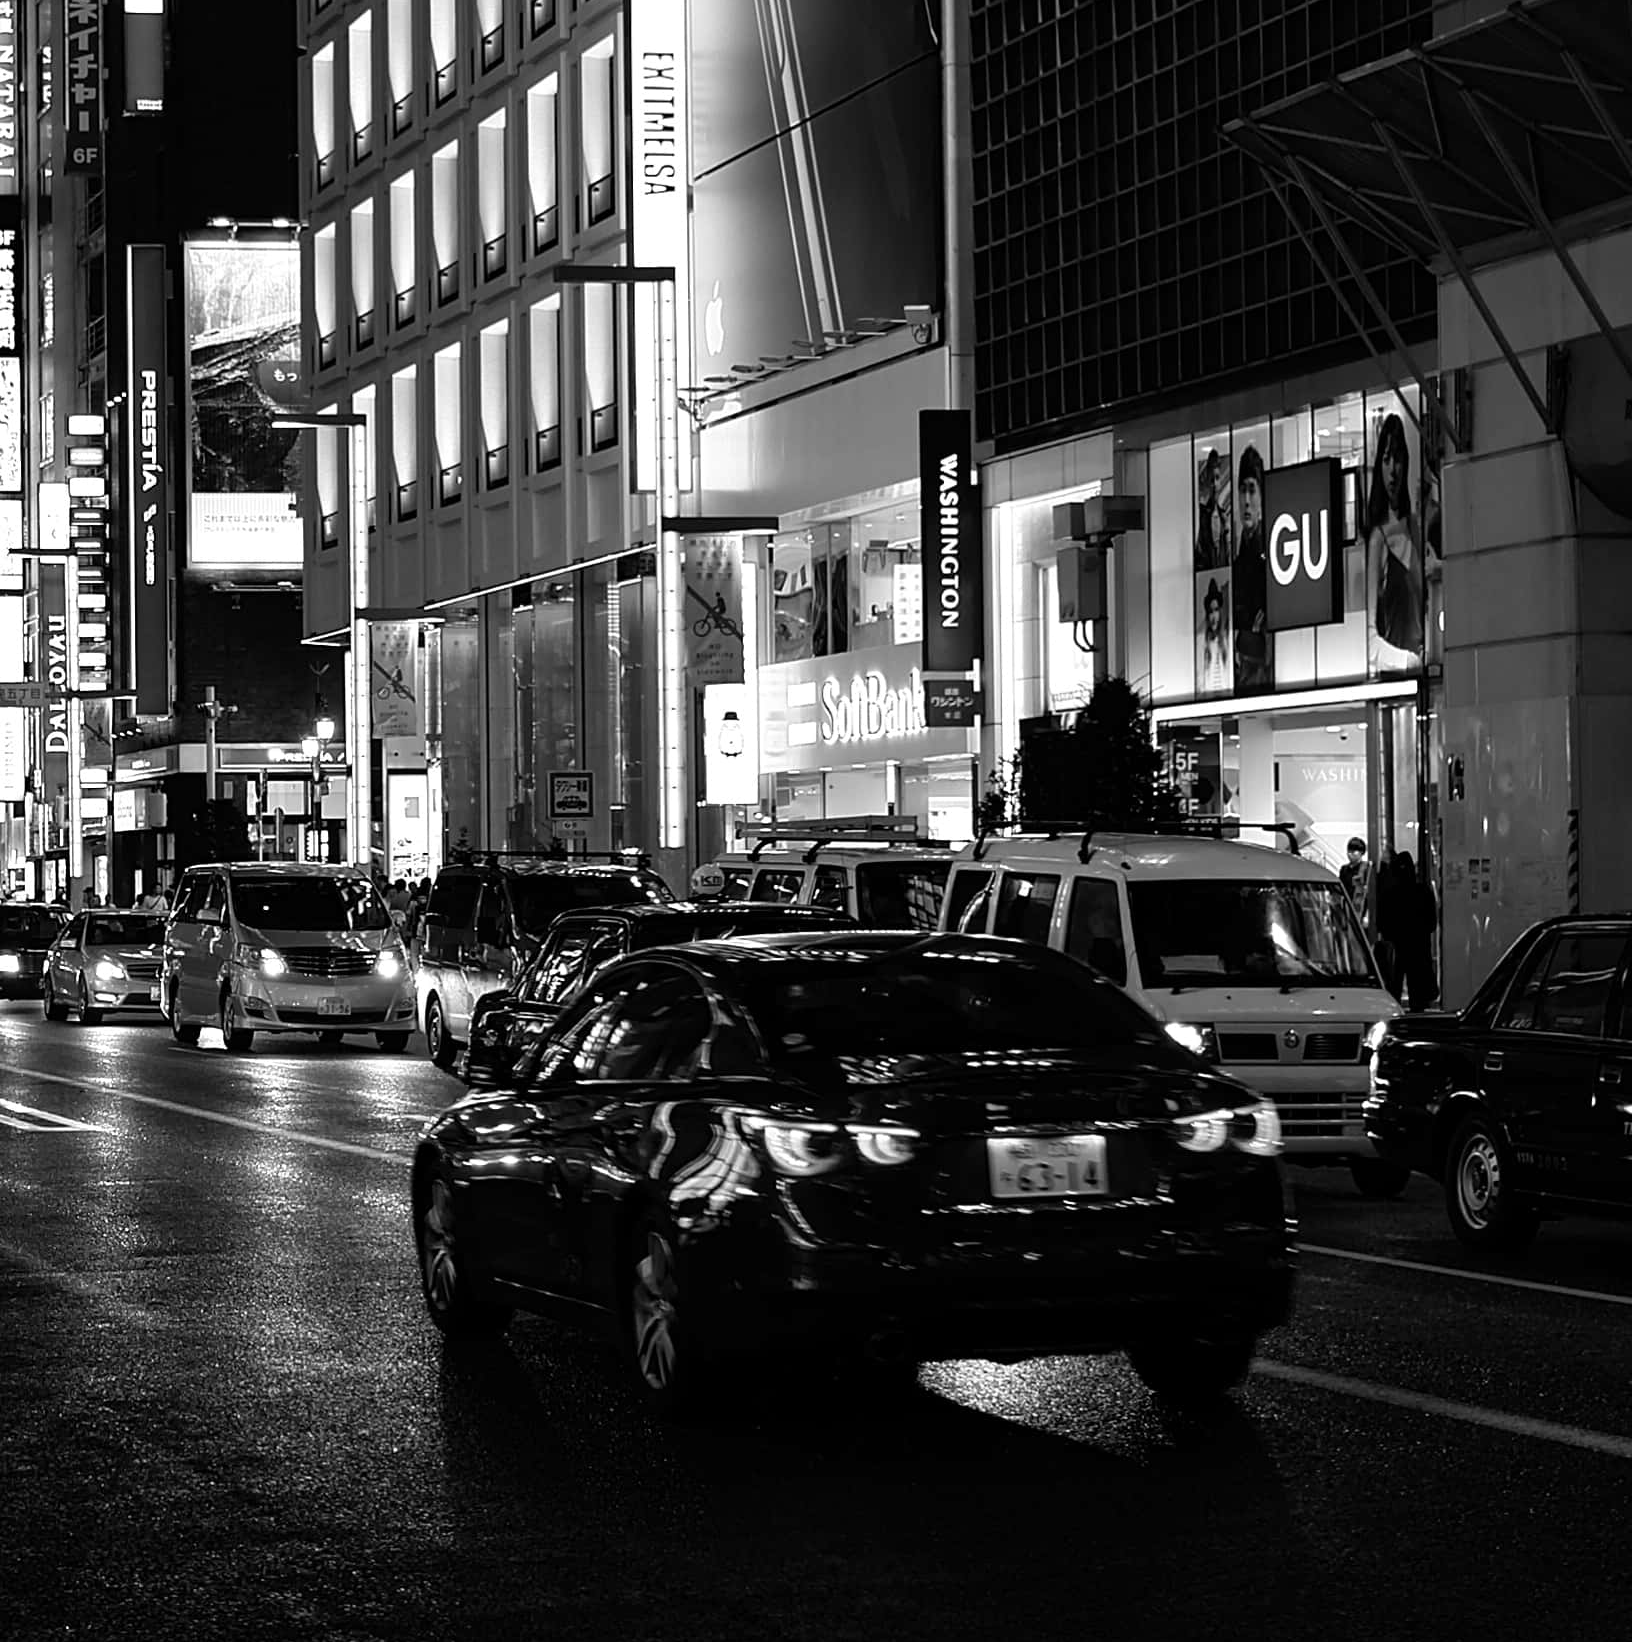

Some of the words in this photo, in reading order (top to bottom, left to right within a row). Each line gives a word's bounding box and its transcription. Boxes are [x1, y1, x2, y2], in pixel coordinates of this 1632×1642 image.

[73, 147, 97, 164] 6F
[642, 51, 675, 197] EXITMELSA
[141, 370, 164, 493] PRESTÍA
[939, 453, 960, 629] WASHINGTON
[1269, 508, 1328, 587] GU
[821, 667, 928, 746] SoftBank
[1175, 752, 1199, 771] 5F
